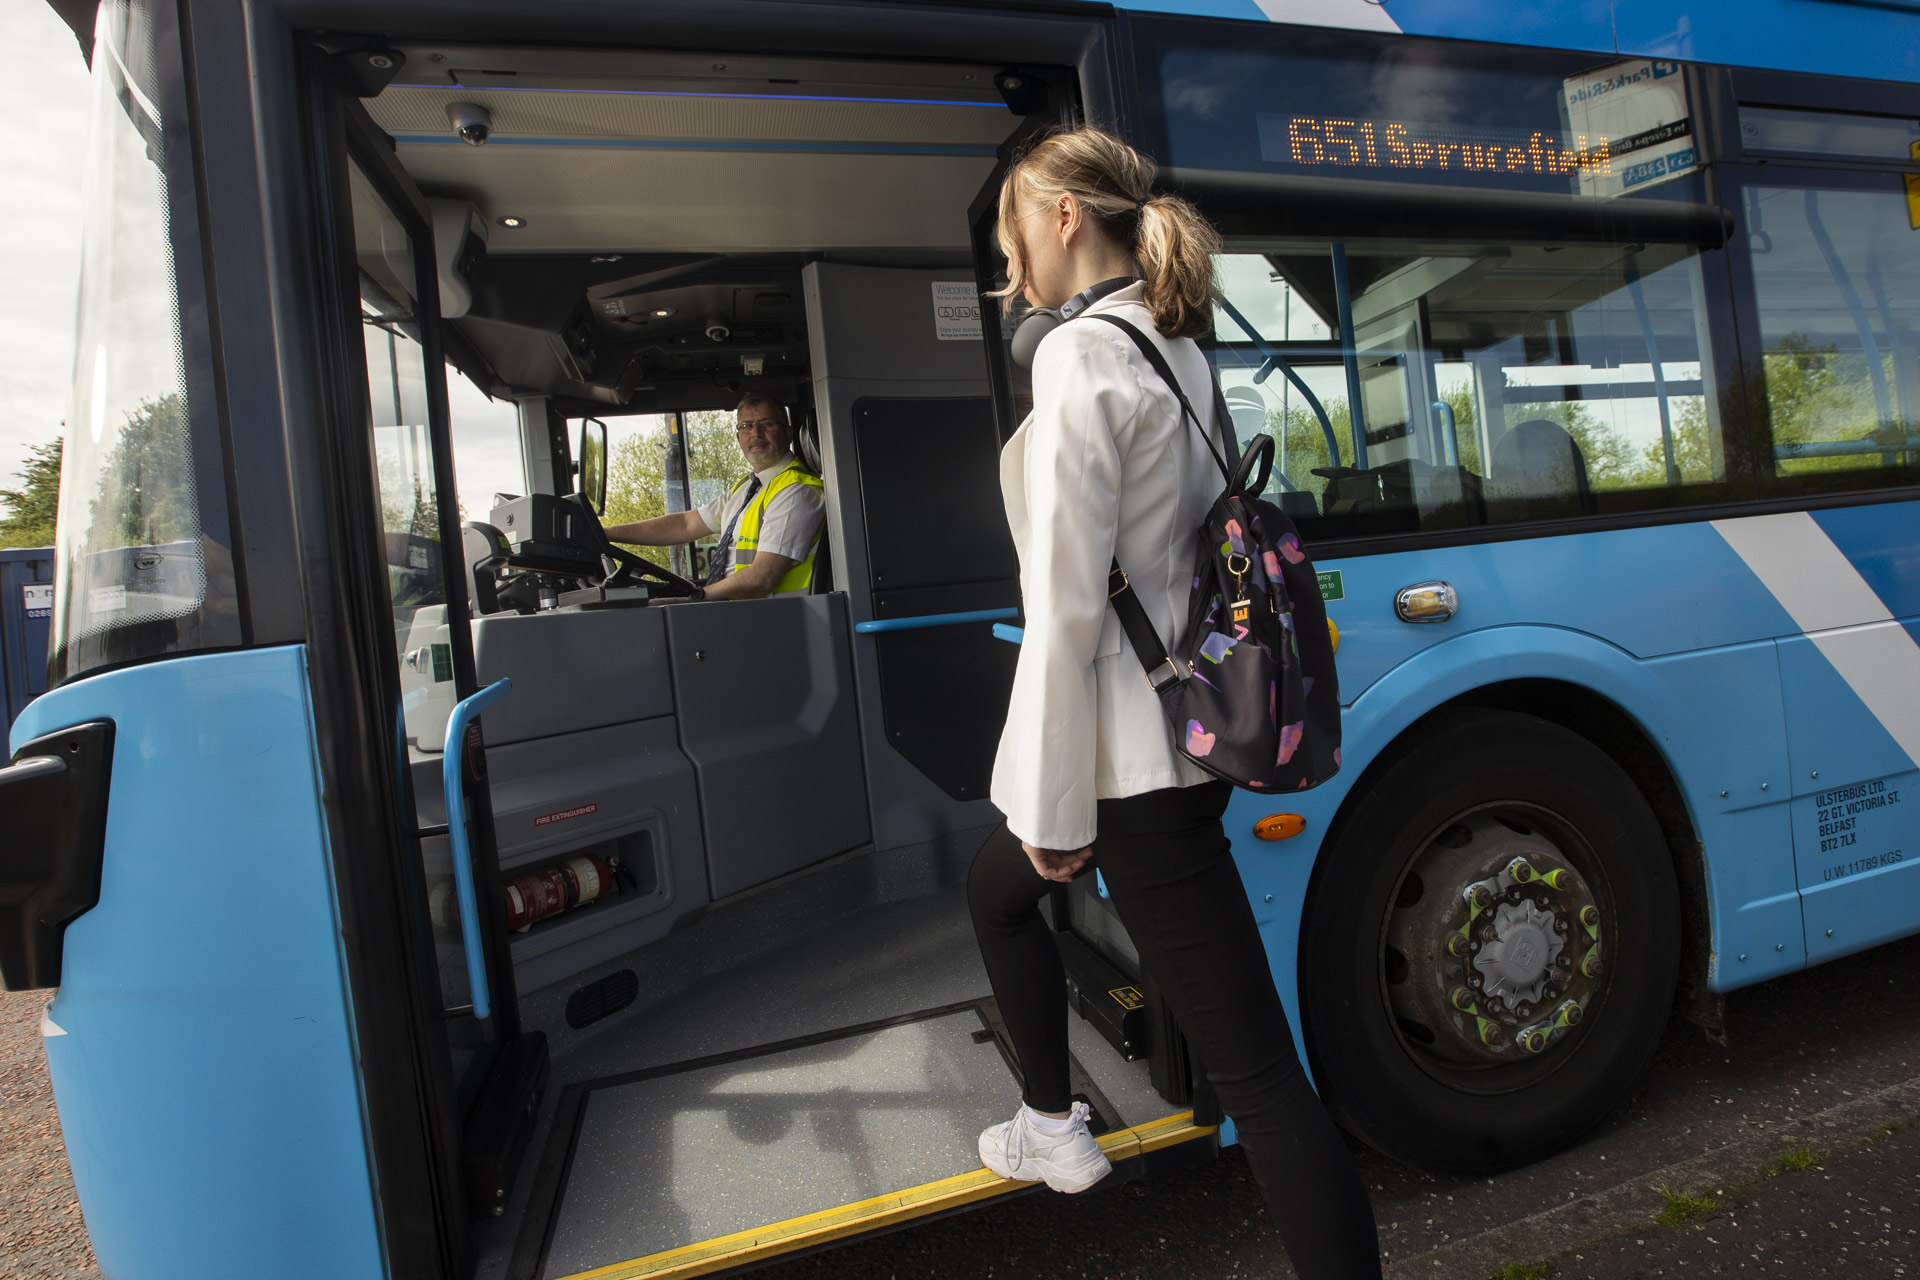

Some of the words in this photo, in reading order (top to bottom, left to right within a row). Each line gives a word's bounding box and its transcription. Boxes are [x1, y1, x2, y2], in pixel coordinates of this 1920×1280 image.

[1289, 117, 1382, 166] 651
[1385, 123, 1612, 177] Sprucefield
[936, 284, 971, 295] Welcome
[1816, 784, 1867, 808] ULSTERBUS
[1868, 781, 1887, 795] LTD.
[536, 815, 551, 824] FIRE
[551, 805, 596, 821] EXTINGUISHER
[1817, 809, 1830, 823] 22
[1831, 805, 1845, 819] GT.
[1846, 795, 1887, 815] VICTORIA
[1887, 790, 1901, 805] ST.
[1818, 817, 1857, 837] BELFAST
[1821, 837, 1839, 852] BT2
[1839, 832, 1857, 848] 7LX
[1879, 849, 1903, 866] KGS
